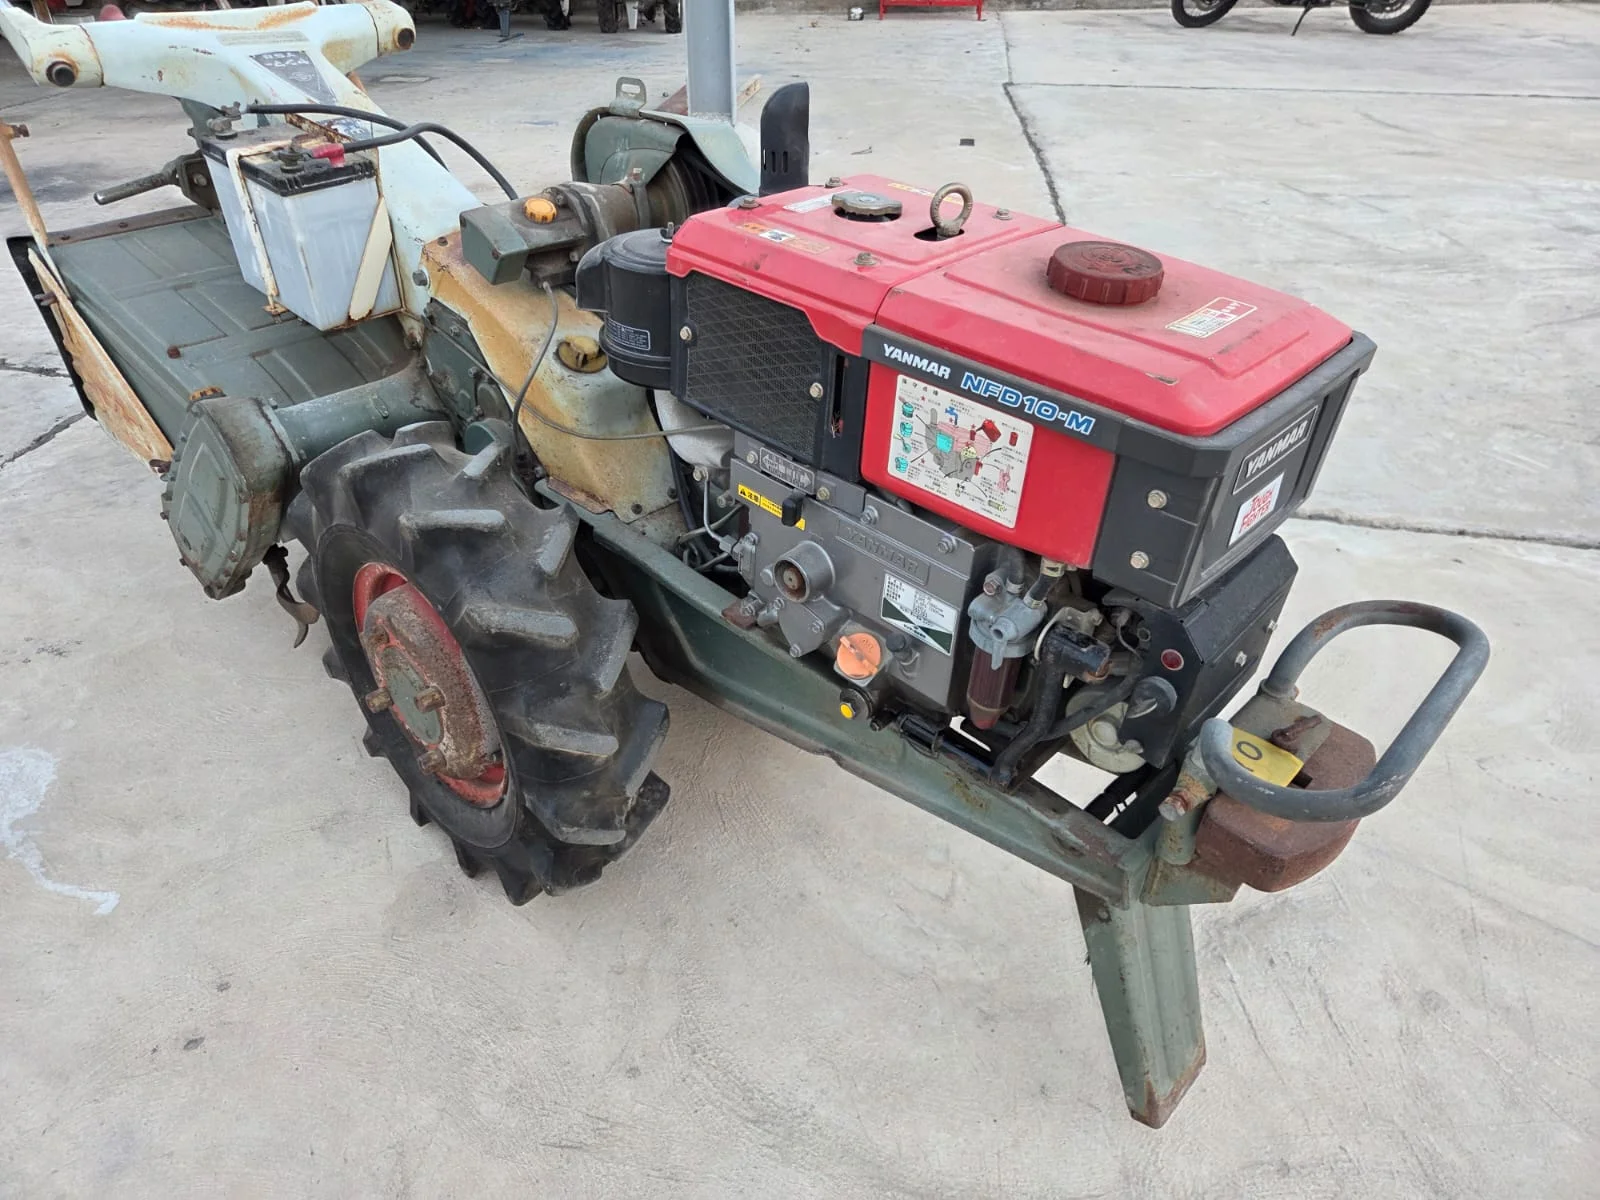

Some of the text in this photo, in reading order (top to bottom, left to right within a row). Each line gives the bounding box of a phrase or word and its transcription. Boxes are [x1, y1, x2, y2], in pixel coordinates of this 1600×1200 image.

[883, 343, 951, 380] YANMAR
[960, 372, 1096, 435] NFD10-M
[1246, 420, 1308, 478] YANMAR
[845, 526, 918, 574] YANMAR
